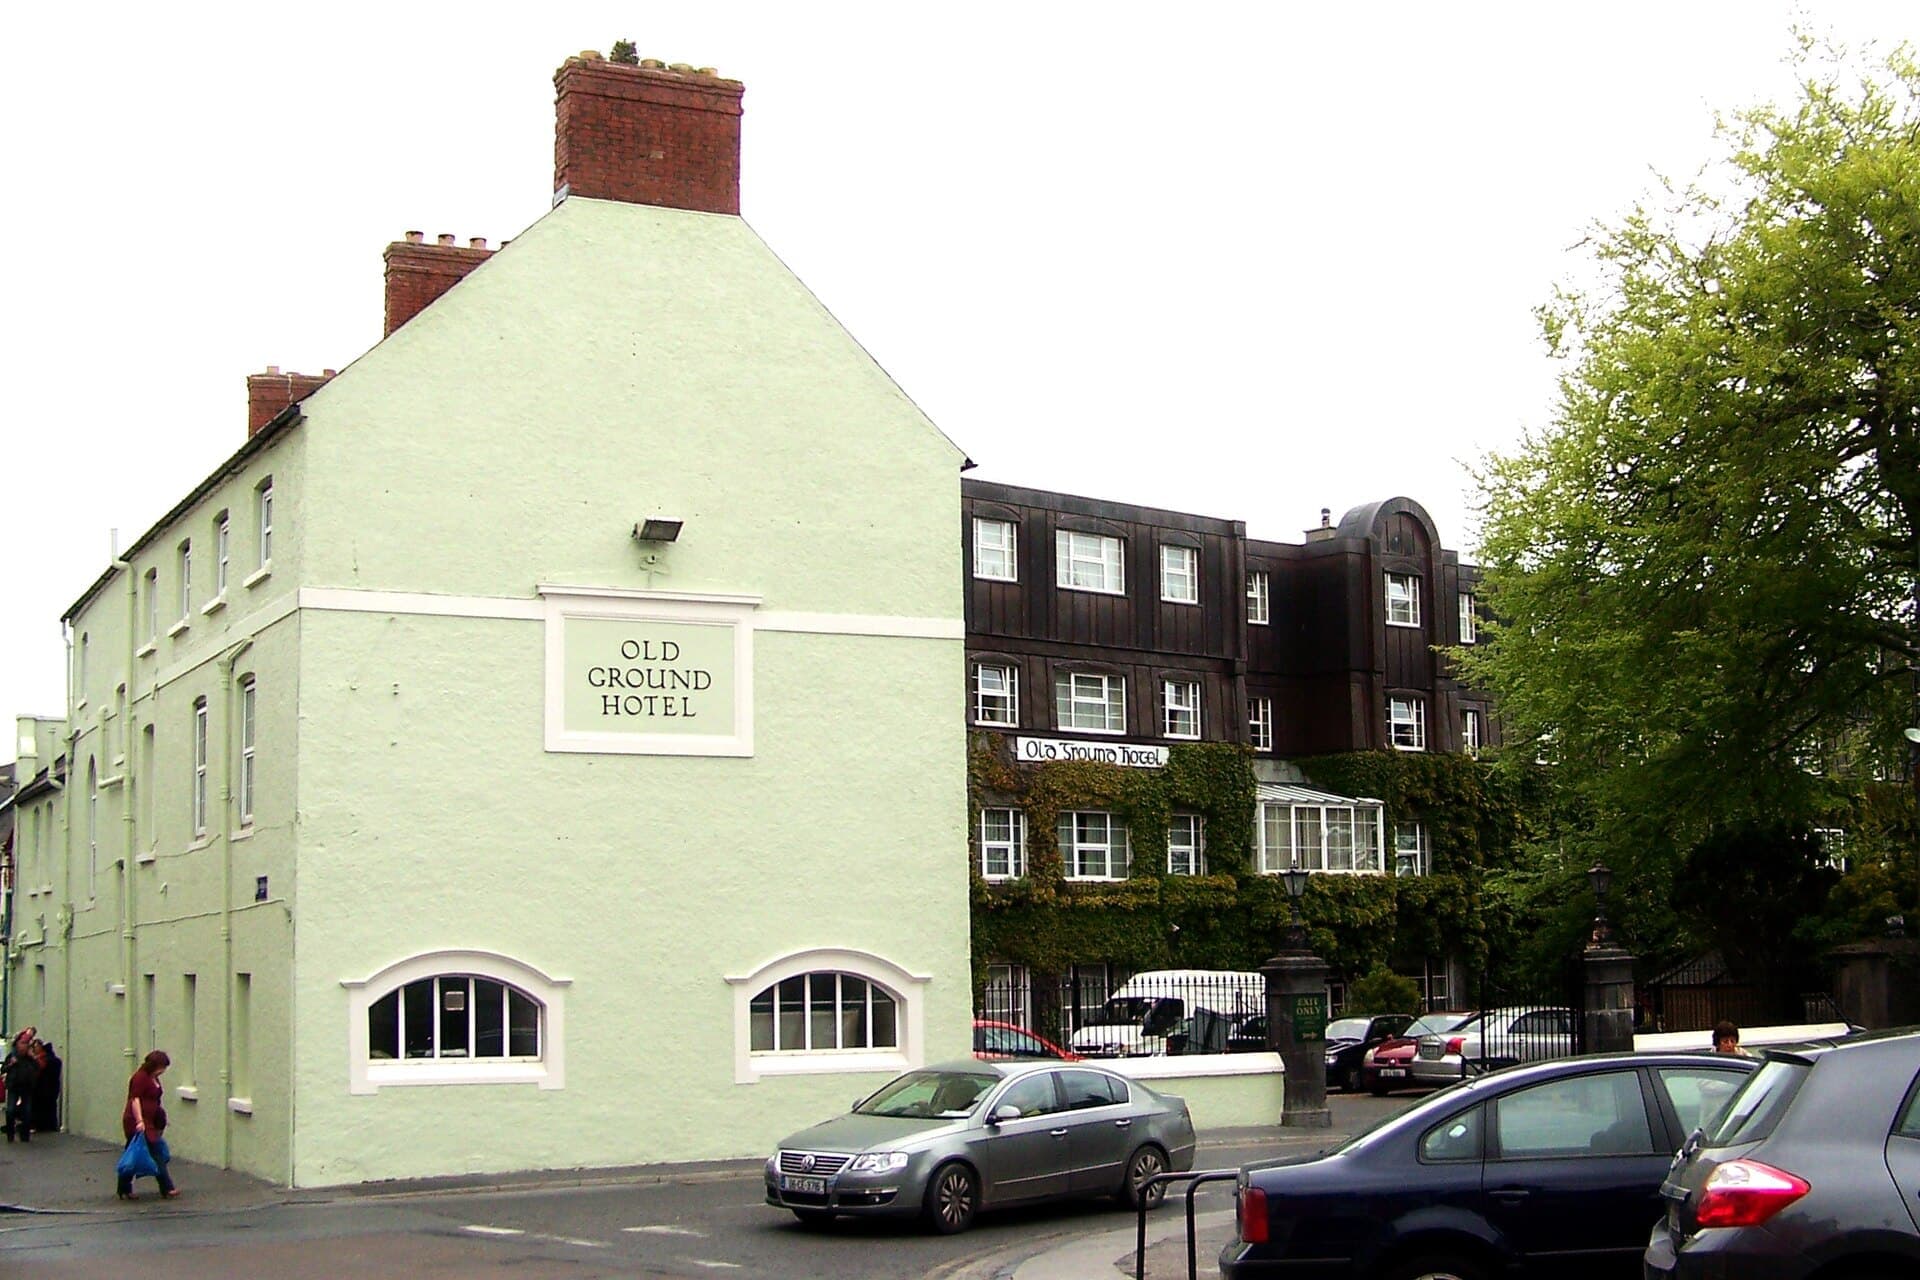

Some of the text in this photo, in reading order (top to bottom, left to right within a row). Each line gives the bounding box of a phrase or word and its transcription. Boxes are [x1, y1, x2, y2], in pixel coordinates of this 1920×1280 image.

[621, 640, 680, 661] OLD
[588, 667, 711, 690] GROUND
[602, 695, 697, 717] HOTEL
[1026, 740, 1056, 759] Old
[1296, 1007, 1321, 1016] ONLY
[1297, 997, 1319, 1006] EXIT
